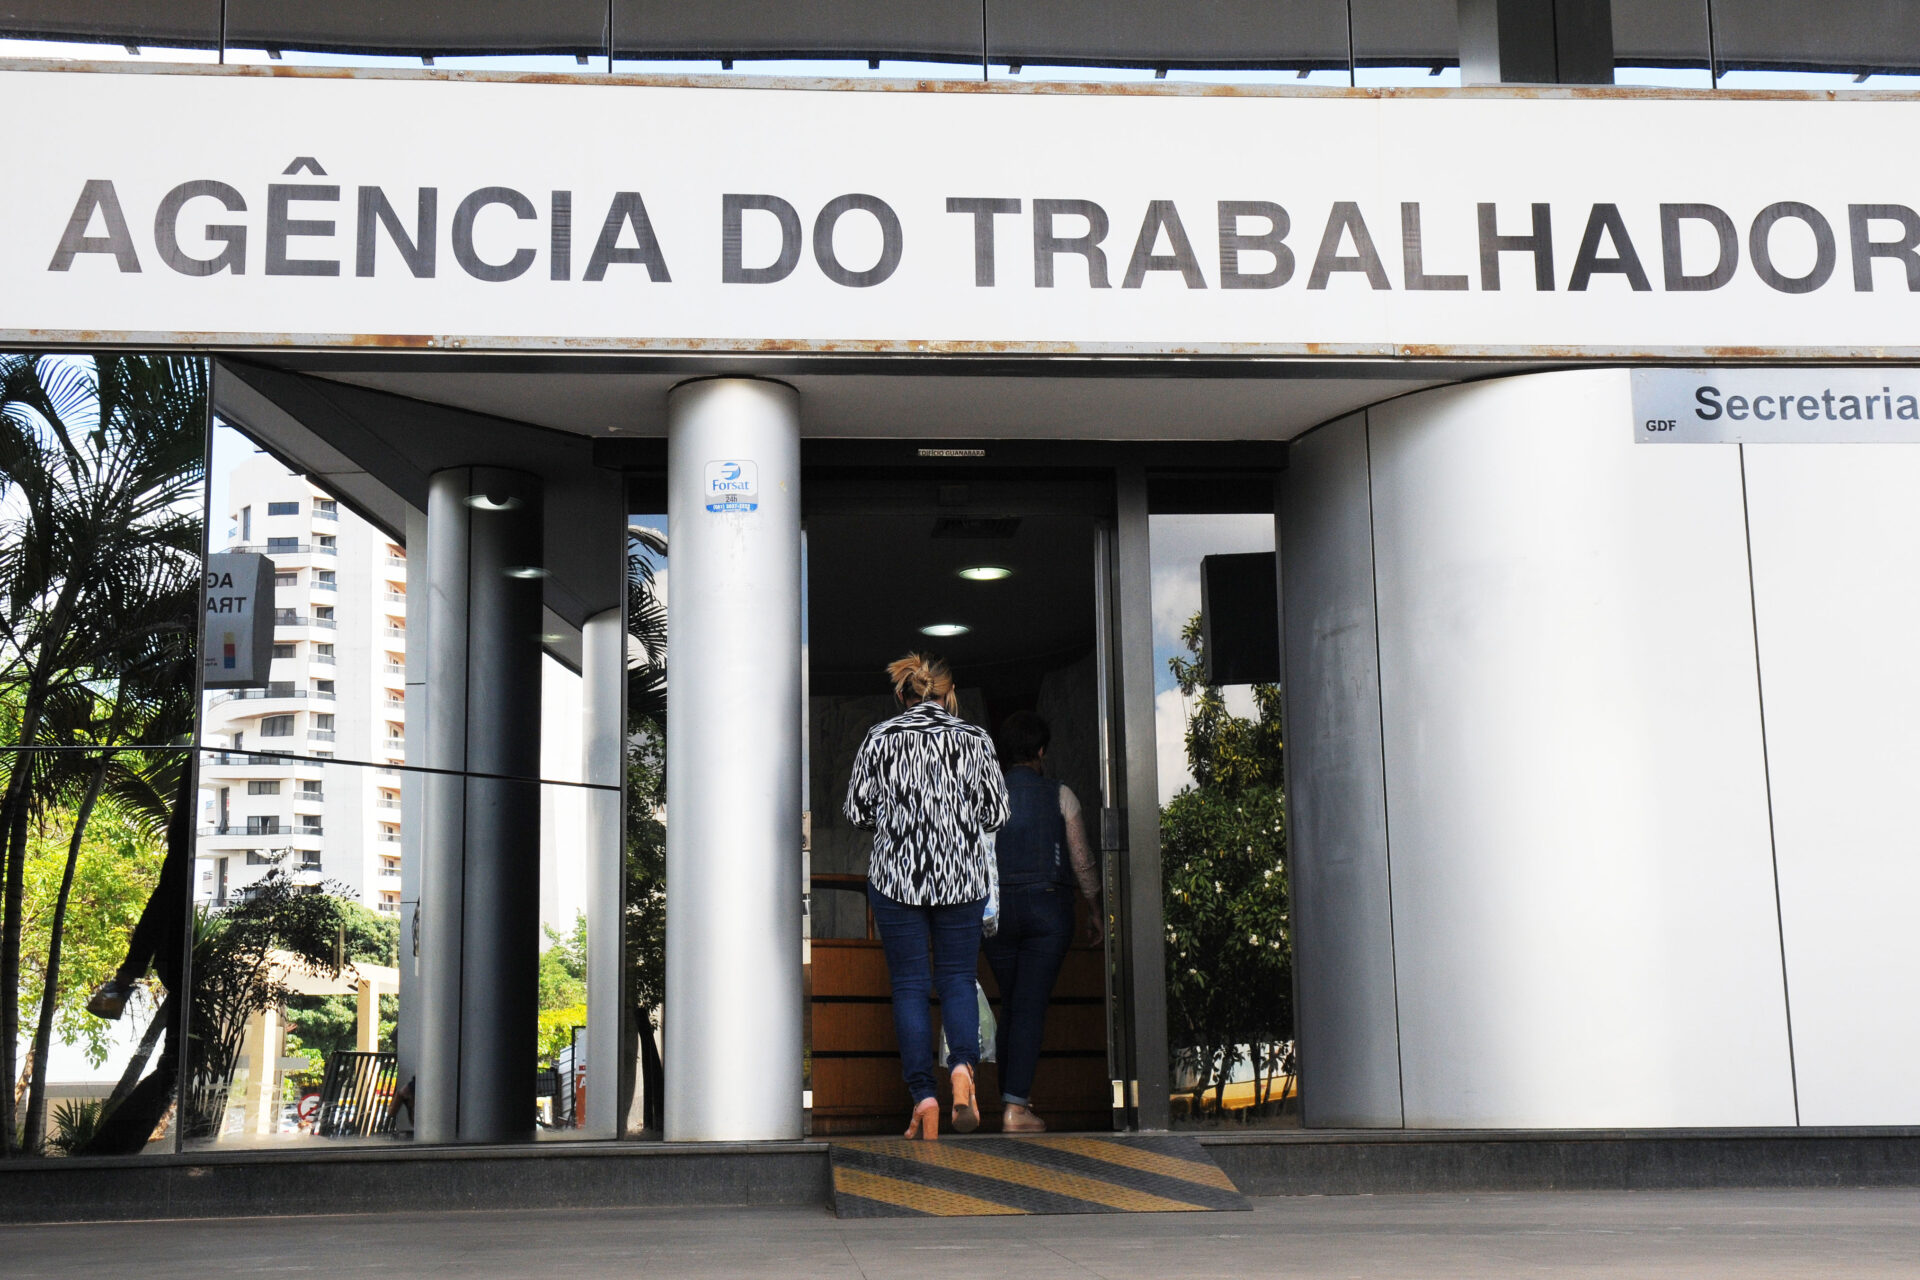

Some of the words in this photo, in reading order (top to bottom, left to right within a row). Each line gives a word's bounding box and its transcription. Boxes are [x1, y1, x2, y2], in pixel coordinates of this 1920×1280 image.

[48, 156, 673, 283] AGÊNCIA
[722, 193, 903, 288] DO
[945, 196, 1920, 295] TRABALHADOR
[1694, 385, 1920, 421] Secretaria
[1645, 419, 1677, 432] GDF
[712, 479, 750, 491] Forsat
